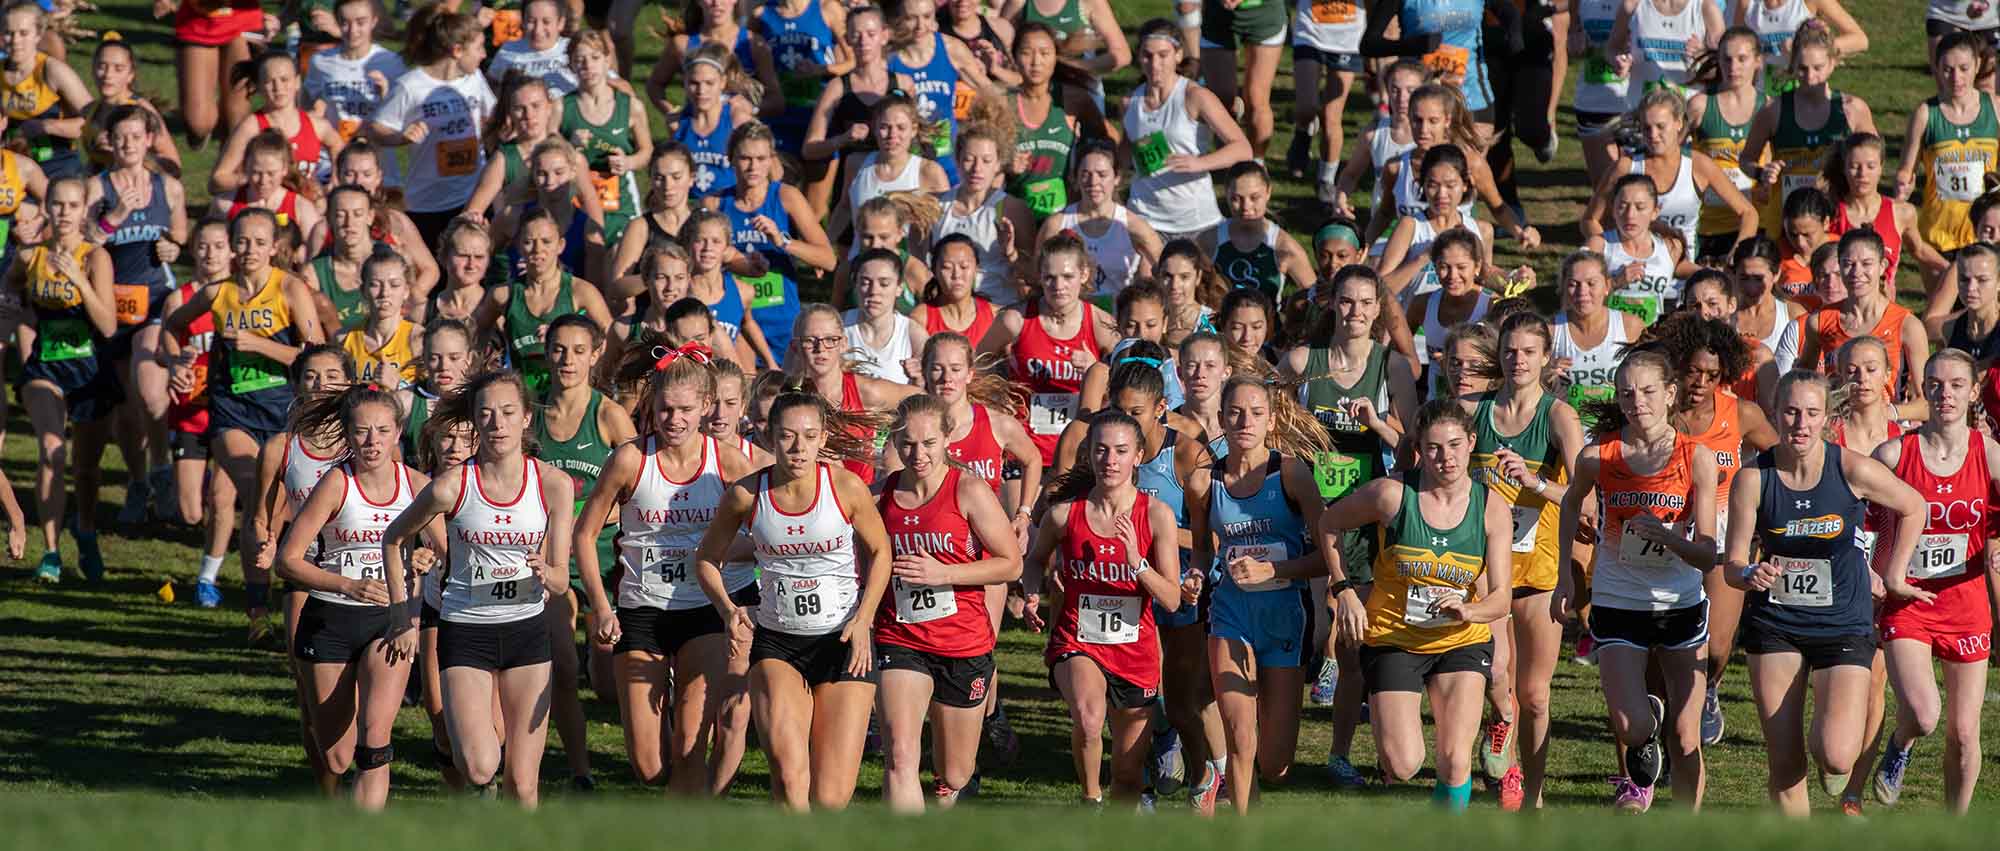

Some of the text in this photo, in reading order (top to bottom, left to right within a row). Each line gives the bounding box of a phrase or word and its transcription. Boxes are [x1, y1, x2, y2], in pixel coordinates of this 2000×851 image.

[1950, 175, 1969, 192] 31
[1029, 192, 1056, 208] 247
[223, 308, 275, 331] AACS
[1032, 396, 1044, 408] A
[1047, 406, 1069, 424] 14
[1325, 466, 1360, 486] 313
[637, 508, 715, 525] MARYVAL
[1923, 498, 1984, 531] PCS
[1223, 518, 1274, 537] MOUNT
[1784, 519, 1840, 537] BLAZERS
[456, 529, 545, 546] MARYVALE
[894, 532, 954, 556] ALDING
[645, 548, 654, 562] A
[1638, 540, 1666, 557] 74
[344, 552, 354, 567] A
[1919, 548, 1955, 569] 150
[474, 566, 485, 580] A
[660, 562, 686, 583] 54
[1070, 560, 1138, 583] SPALDIN
[490, 580, 518, 600] 48
[776, 582, 786, 596] A
[1411, 585, 1420, 599] A
[1781, 573, 1819, 595] 142
[792, 593, 821, 617] 69
[910, 587, 937, 611] 26
[1079, 596, 1091, 611] A
[1097, 611, 1123, 633] 16
